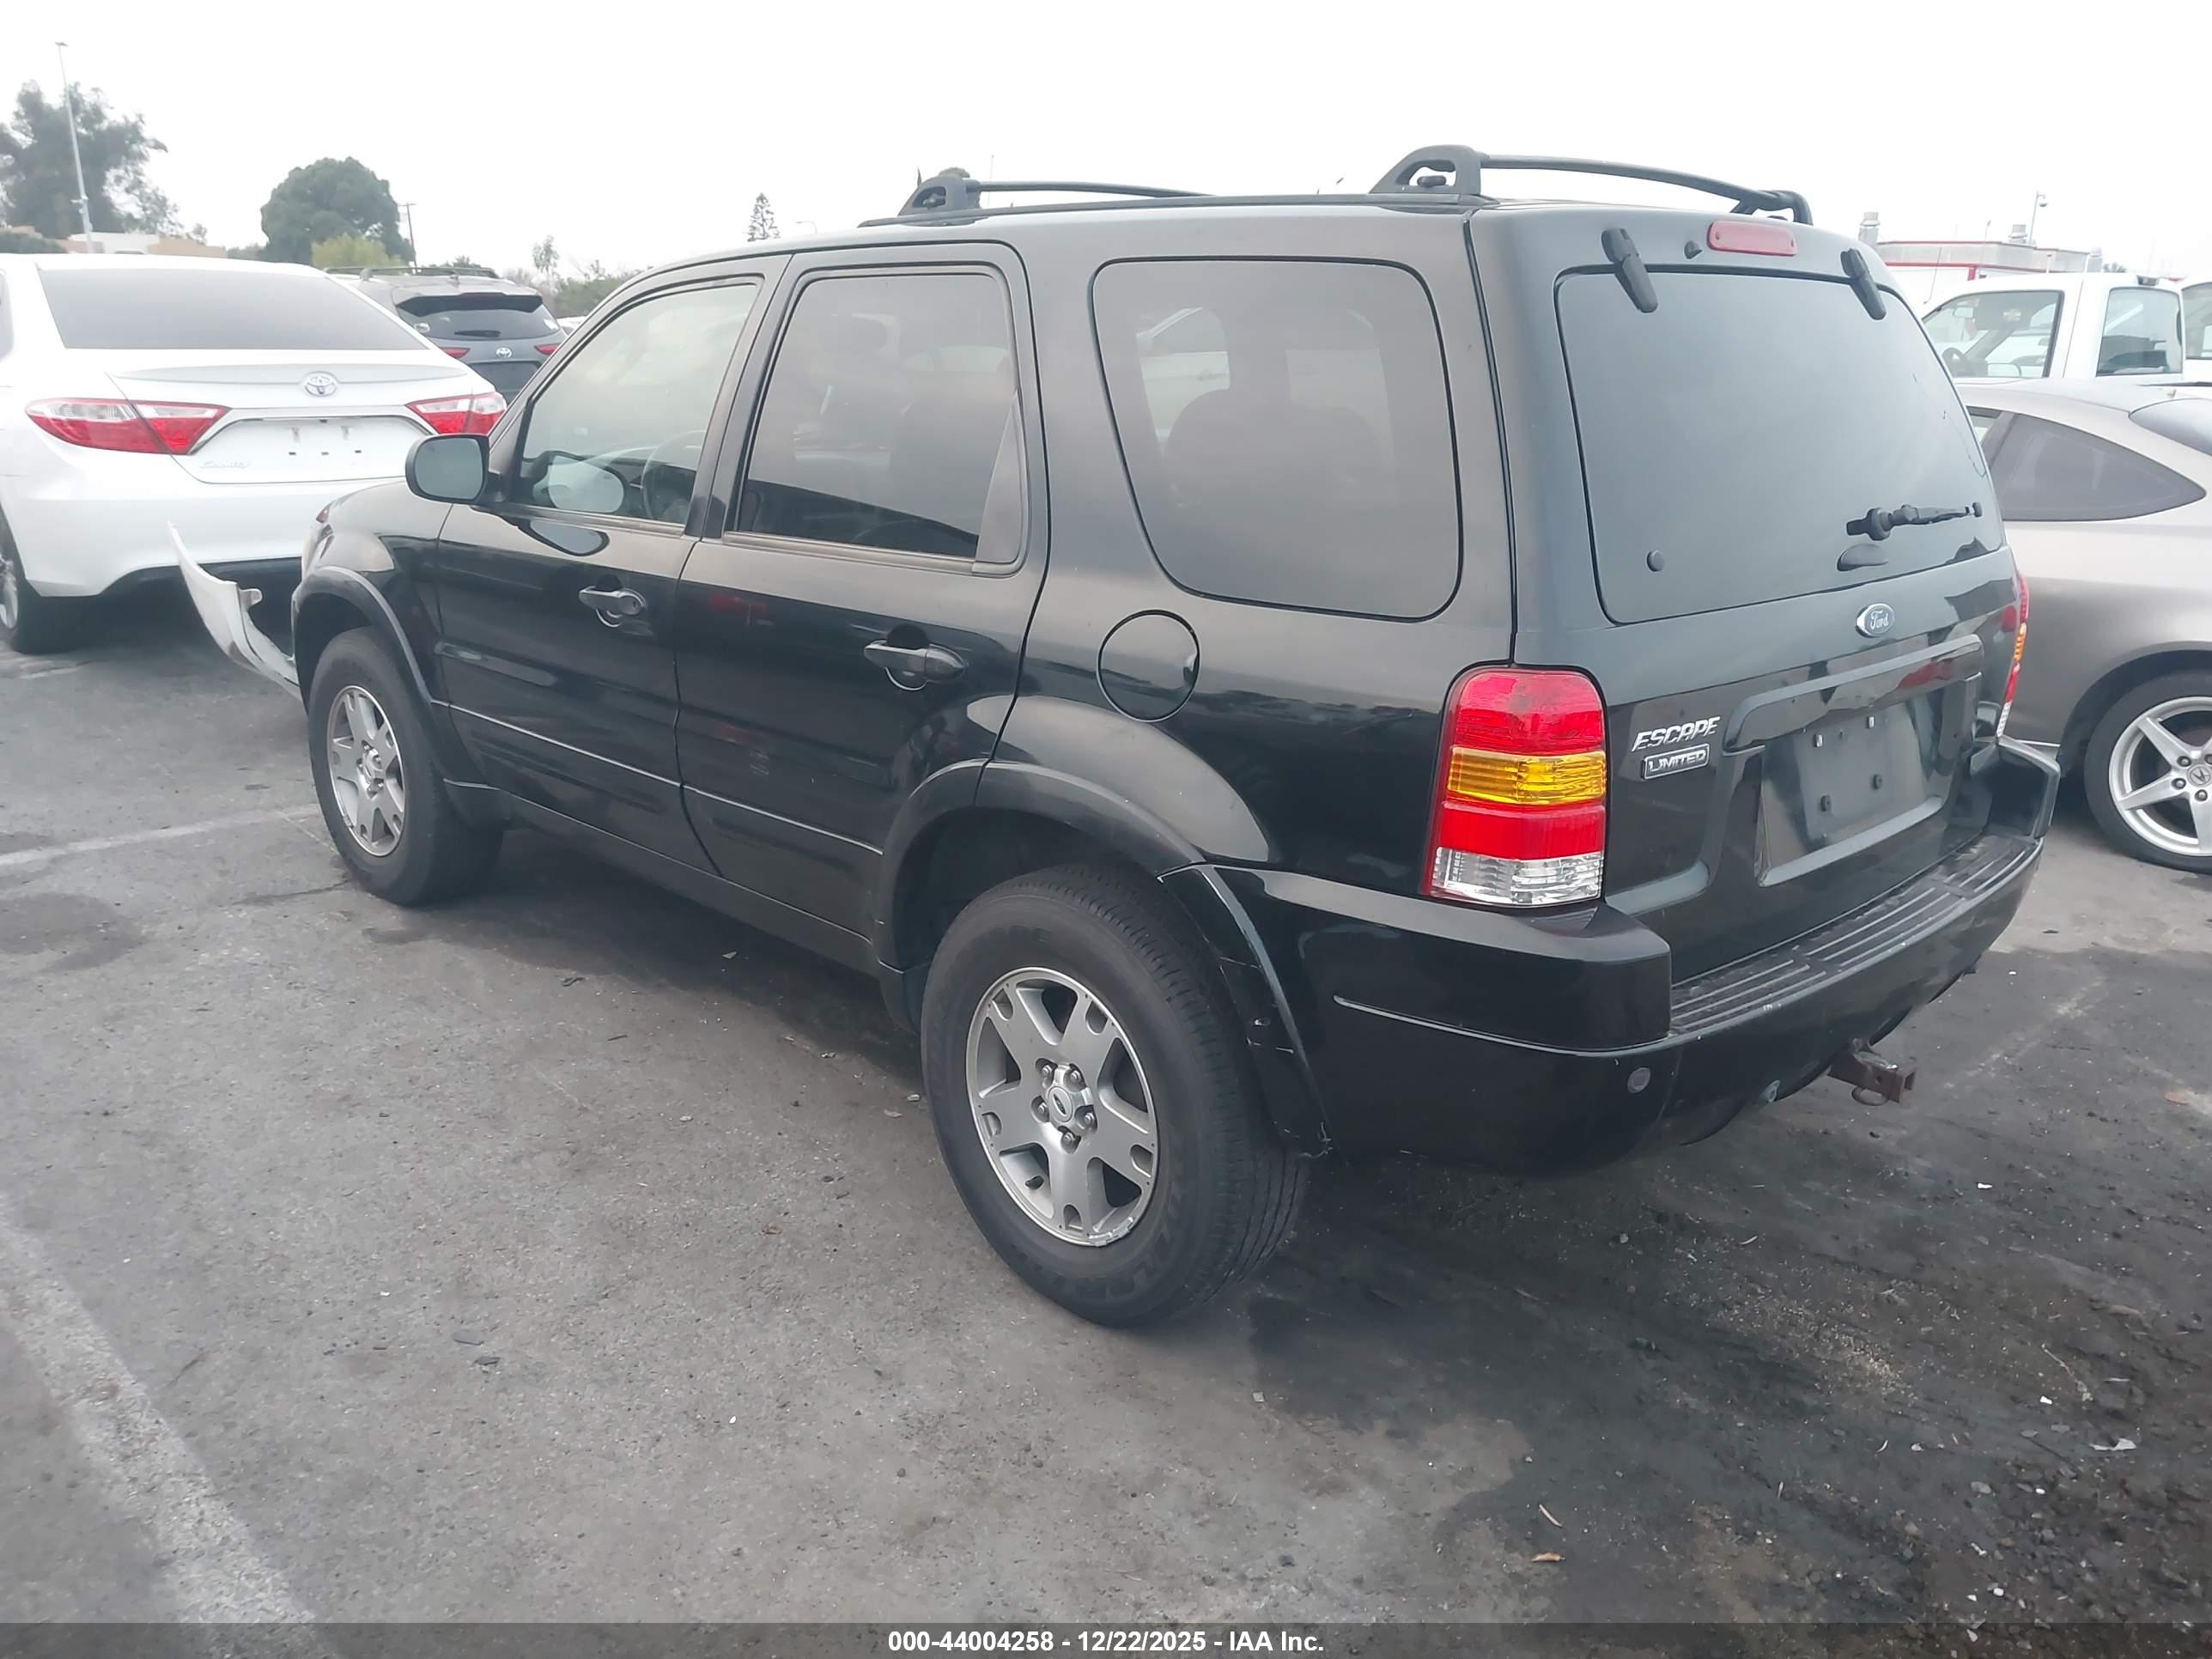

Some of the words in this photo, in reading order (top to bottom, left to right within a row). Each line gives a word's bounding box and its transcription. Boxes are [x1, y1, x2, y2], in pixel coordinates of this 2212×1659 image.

[1869, 609, 1889, 630] Ford
[1632, 716, 1721, 752] ESCAPE
[1648, 749, 1706, 773] LIMITED
